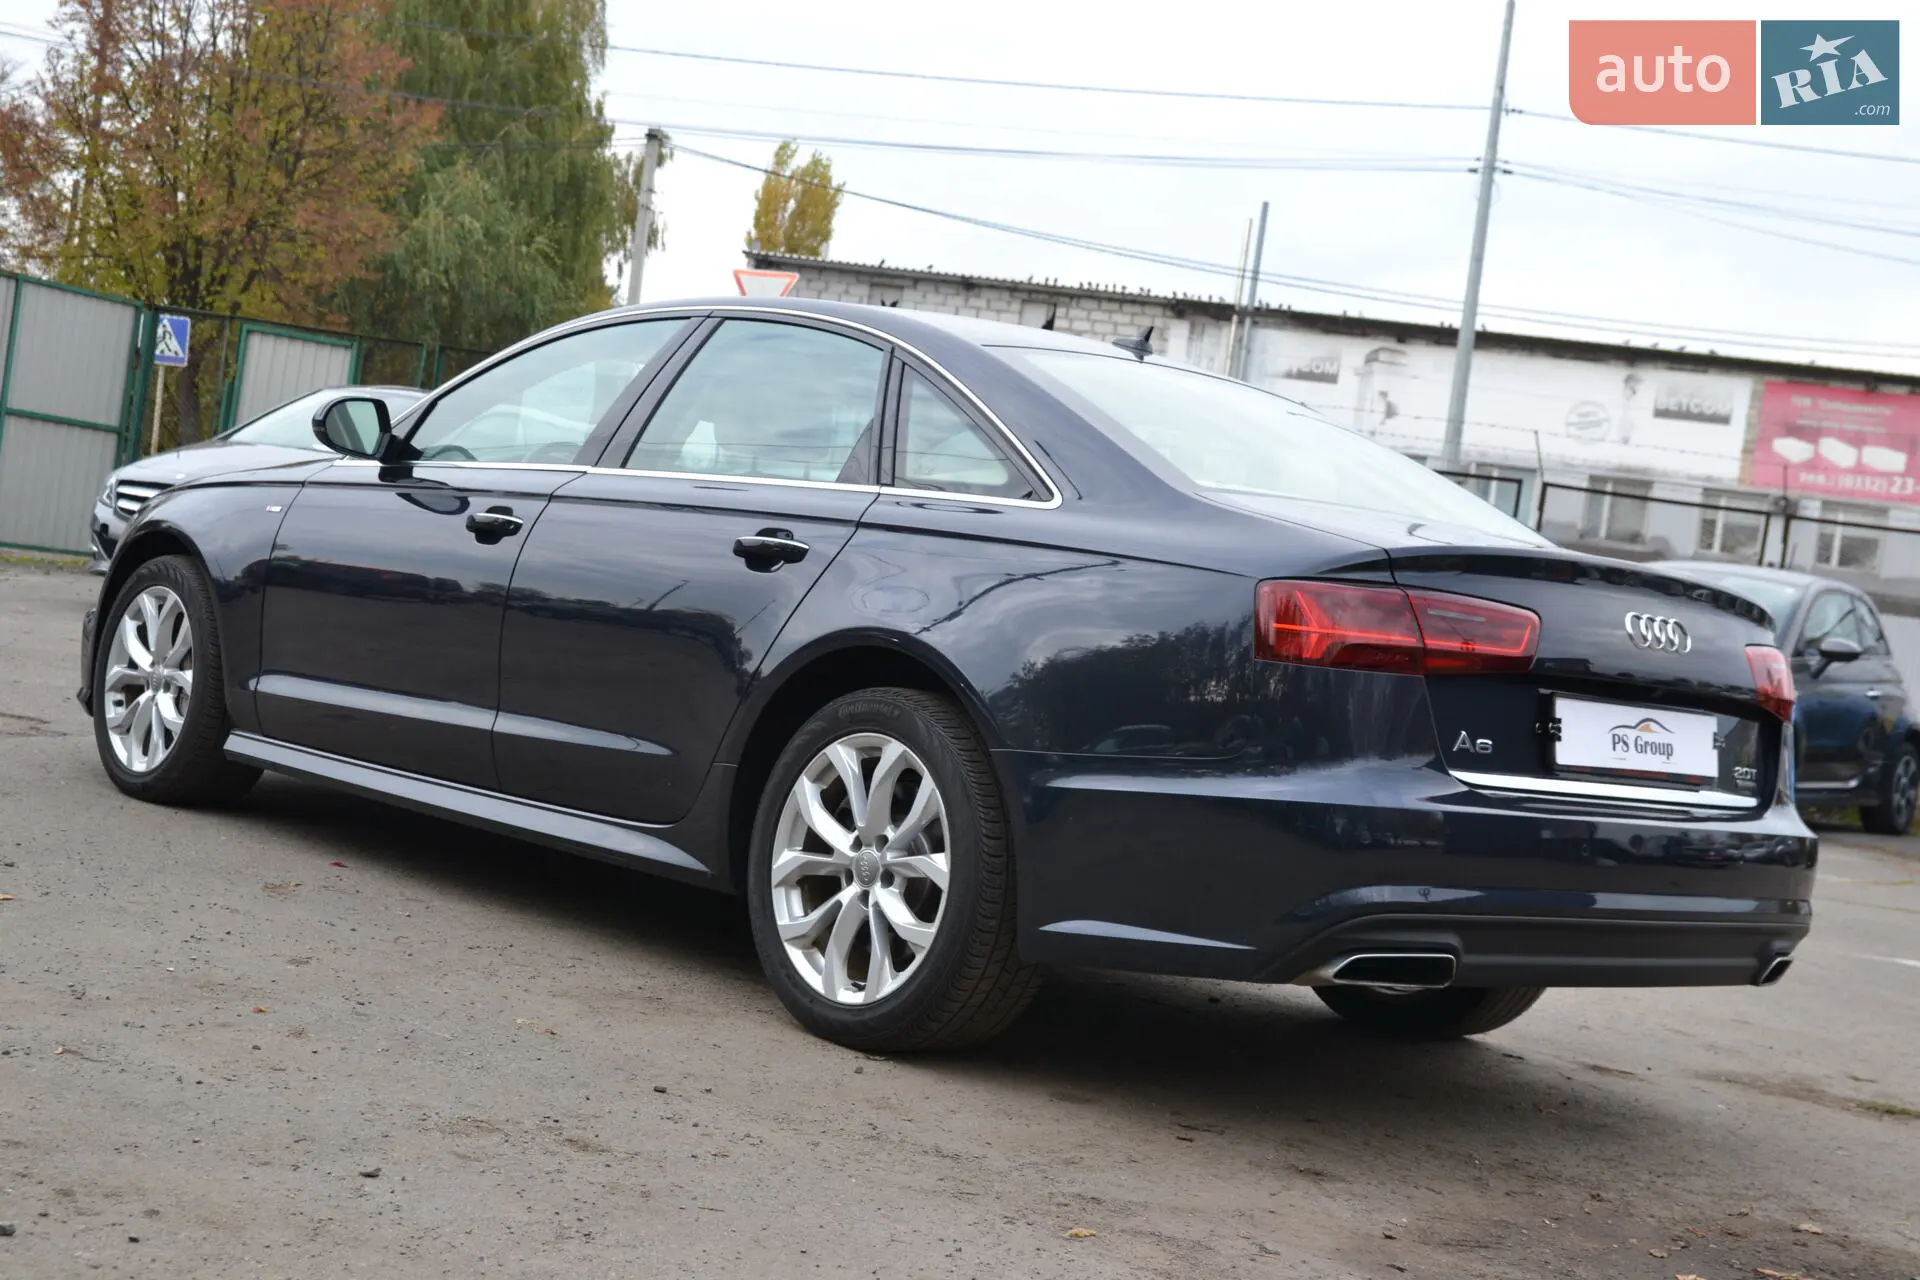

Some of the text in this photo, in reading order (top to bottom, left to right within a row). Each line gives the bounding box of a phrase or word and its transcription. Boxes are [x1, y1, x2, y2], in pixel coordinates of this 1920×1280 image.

[1452, 730, 1493, 753] A6
[1611, 733, 1674, 760] PS Group
